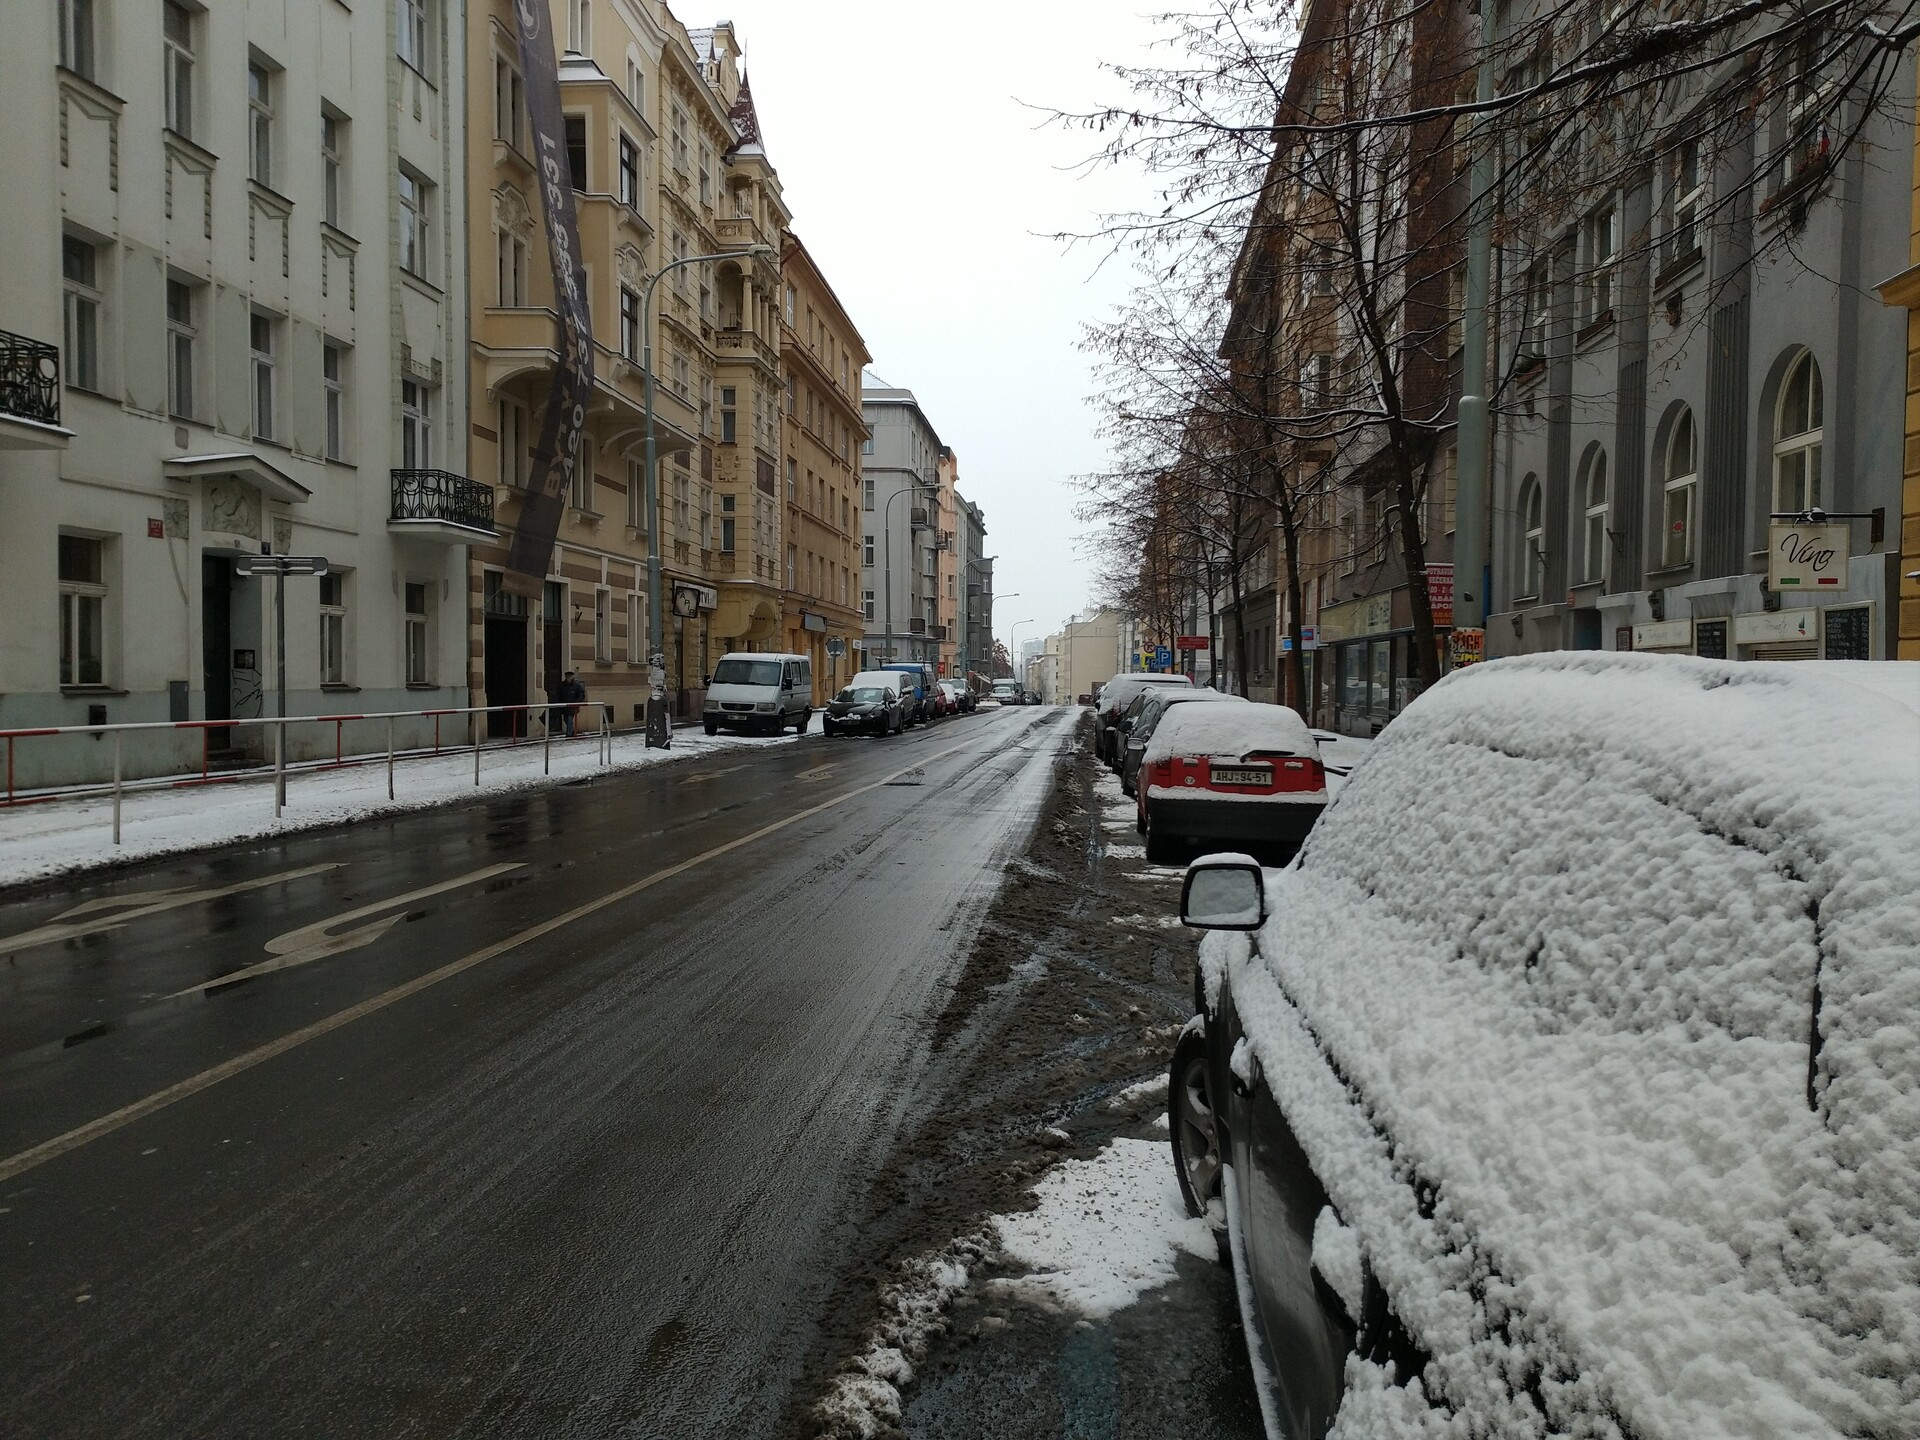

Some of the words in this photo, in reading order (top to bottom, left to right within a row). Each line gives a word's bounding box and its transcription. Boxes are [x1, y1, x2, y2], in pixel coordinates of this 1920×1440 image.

[539, 131, 562, 211] 331
[1216, 772, 1233, 782] AHJ
[1240, 772, 1267, 783] 94-51
